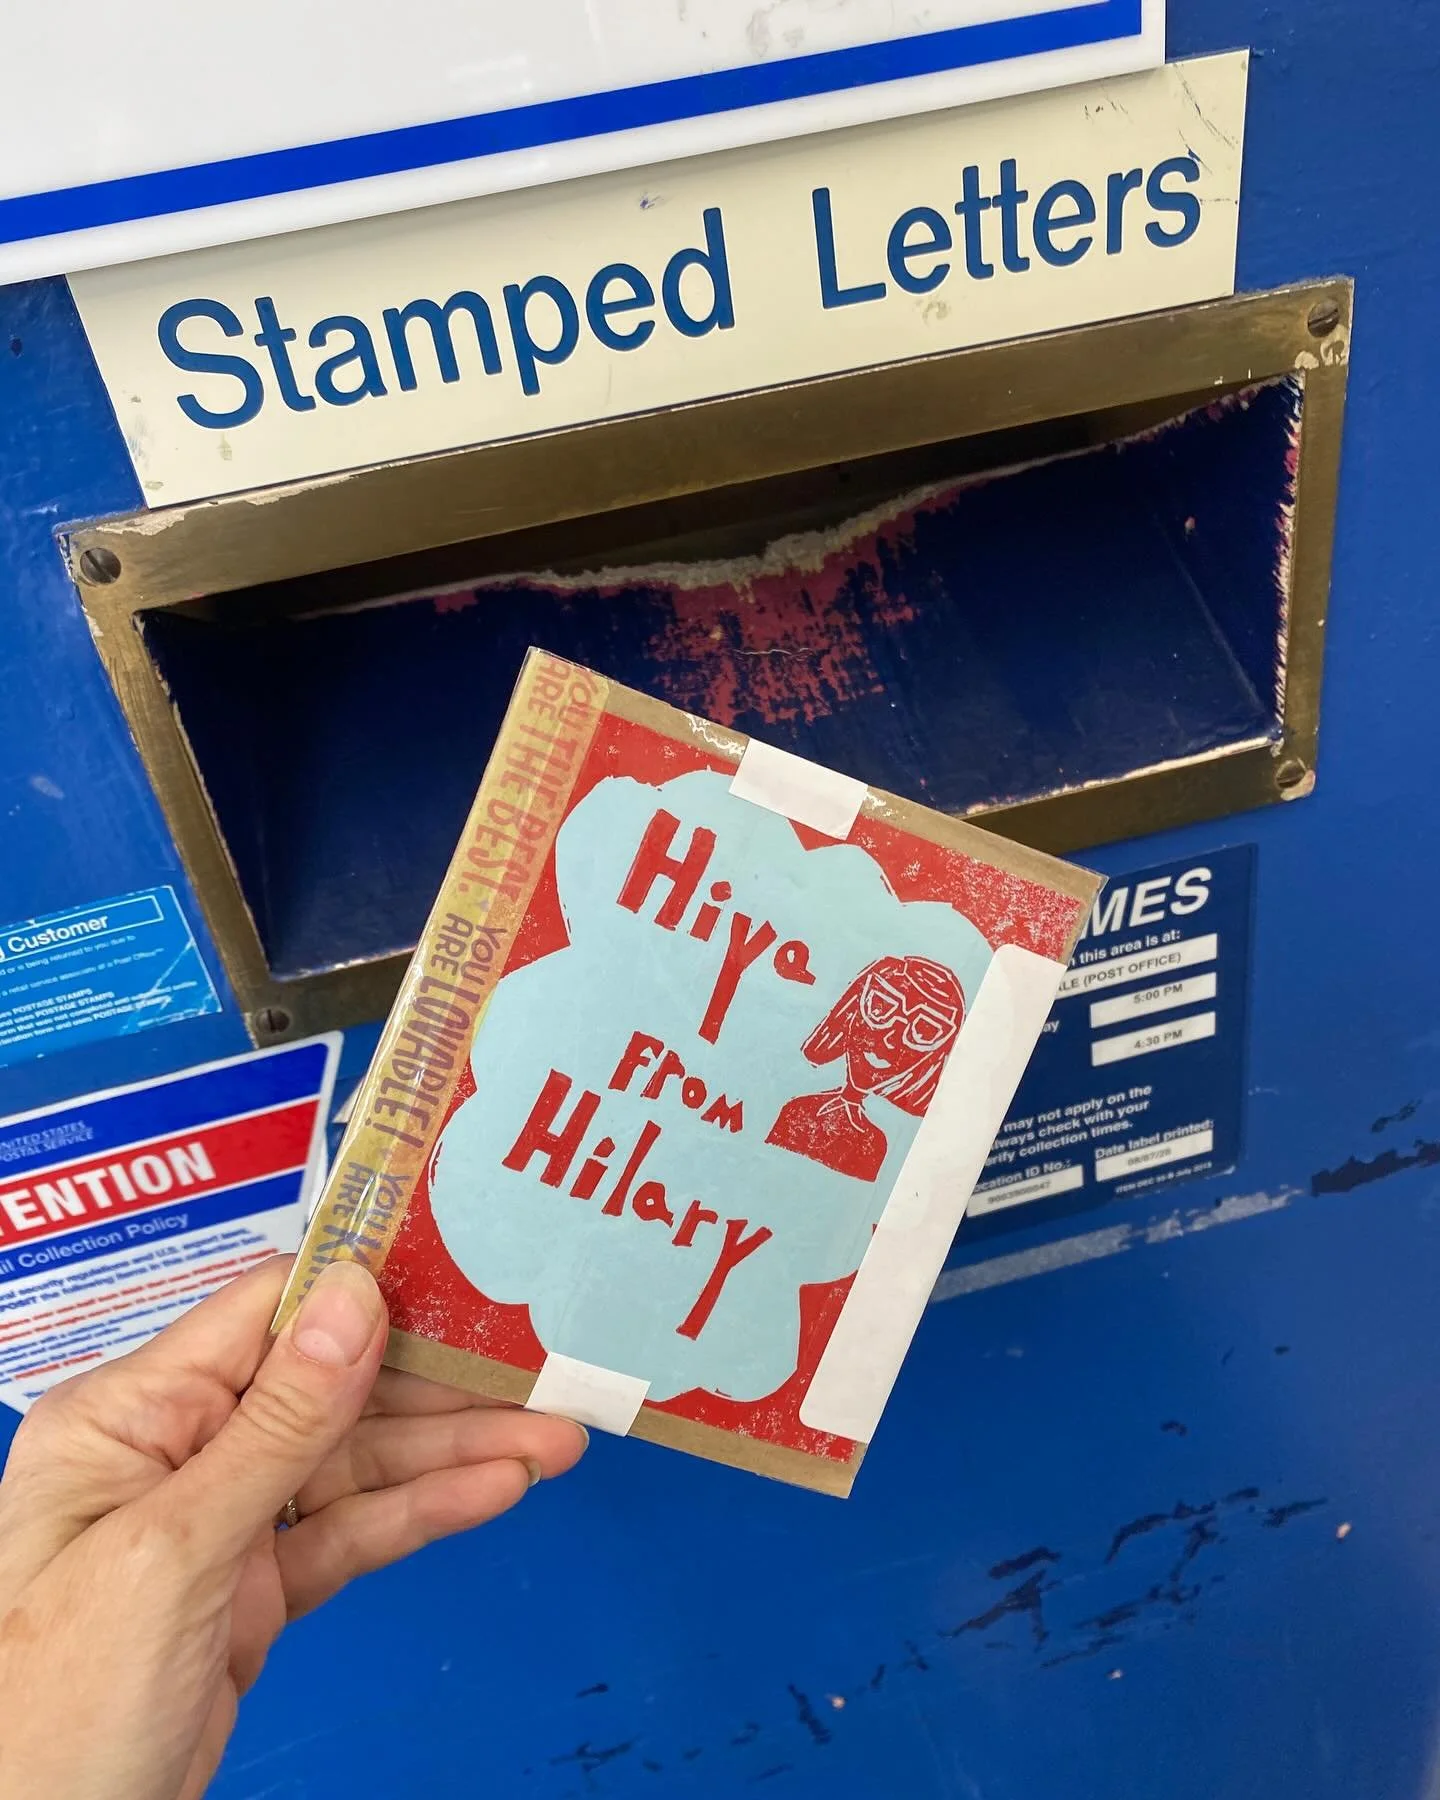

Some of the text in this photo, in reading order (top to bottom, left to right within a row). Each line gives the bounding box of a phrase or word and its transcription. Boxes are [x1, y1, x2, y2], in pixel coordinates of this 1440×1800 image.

[158, 157, 1200, 429] Stamped Letters
[500, 724, 579, 808] THE
[7, 915, 108, 953] Customer
[617, 808, 816, 1045] Hiya
[1079, 948, 1107, 965] this
[1110, 939, 1142, 956] area
[1145, 935, 1159, 947] is
[1162, 928, 1181, 943] at:
[461, 923, 508, 987] YOU
[1083, 966, 1125, 989] (POST
[1128, 951, 1182, 974] OFFICE)
[12, 998, 56, 1015] POSTAGE
[55, 987, 93, 1003] STAMPS
[34, 1001, 78, 1018] POSTAGE
[78, 991, 116, 1007] STAMPS
[1133, 983, 1183, 1004] 5:00 PM
[365, 912, 480, 1148] ARE LOVABLE!
[1133, 1029, 1183, 1049] 4:30 PM
[1003, 1084, 1153, 1133] may not apply on the
[1038, 1118, 1081, 1138] check
[1084, 1108, 1114, 1125] with
[1117, 1101, 1150, 1118] your
[1019, 1131, 1088, 1157] collection
[1090, 1120, 1134, 1138] times.
[1095, 1118, 1214, 1160] Date label printed:
[0, 1141, 216, 1237] ENTION
[1024, 1165, 1040, 1178] ID
[502, 1068, 773, 1341] Hilary
[18, 1231, 123, 1268] Collection
[124, 1212, 189, 1239] Policy
